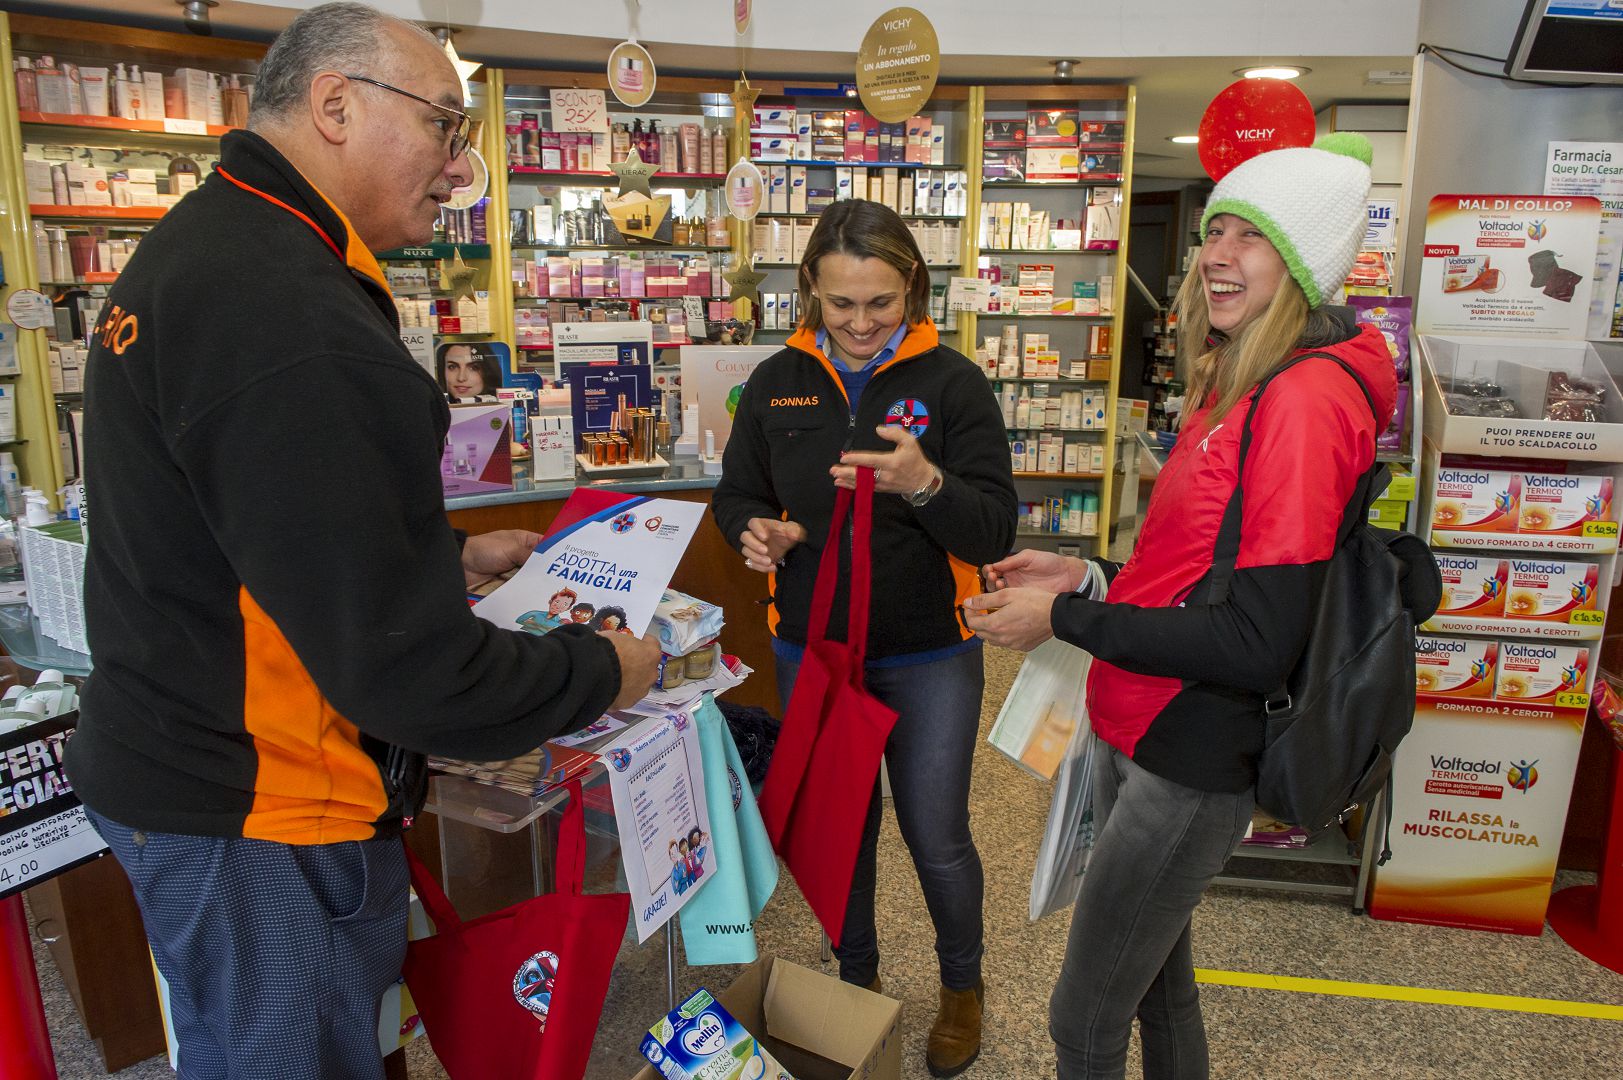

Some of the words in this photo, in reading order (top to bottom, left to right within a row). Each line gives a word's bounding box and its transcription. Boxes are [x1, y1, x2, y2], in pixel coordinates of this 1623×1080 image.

[884, 18, 912, 30] VICHY
[889, 40, 917, 57] regalo
[864, 63, 874, 71] UN
[875, 54, 931, 69] ABBONAMENTO
[555, 92, 602, 107] SCONTO
[565, 108, 596, 124] 25%
[1236, 128, 1275, 139] VICHY
[1554, 149, 1612, 162] Farmacia
[1552, 164, 1578, 175] Quey
[1581, 165, 1594, 174] Dr.
[1458, 200, 1490, 210] MAL
[1495, 200, 1510, 210] DI
[1514, 200, 1573, 212] COLLO?
[1601, 201, 1623, 209] ERVIZ
[1479, 220, 1524, 230] Voltadol
[402, 336, 424, 344] RAC
[770, 396, 819, 406] DONNAS
[1486, 428, 1512, 437] PUOI
[1515, 429, 1573, 439] PRENDERE
[1576, 432, 1595, 440] QUI
[1493, 438, 1515, 446] TUO
[1519, 439, 1597, 451] SCALDACOLLO
[1438, 471, 1489, 484] Voltadol
[1525, 475, 1579, 488] Voltadol
[1438, 482, 1473, 490] TERMICO
[1487, 539, 1530, 547] FORMATO
[1557, 542, 1594, 550] CEROTTI
[569, 546, 599, 558] progetto
[555, 552, 617, 575] ADOTTA
[619, 570, 638, 578] una
[1437, 558, 1478, 570] oltadol
[1512, 561, 1565, 574] Voltadol
[547, 563, 631, 592] FAMIGLIA
[1475, 625, 1517, 633] FORMATO
[1416, 639, 1466, 652] Voltadol
[1504, 645, 1556, 658] Voltadol
[1436, 703, 1483, 713] FORMATO
[1512, 709, 1553, 718] CEROTTI
[1431, 755, 1501, 774] Voltadol
[1432, 770, 1478, 781] TERMICO
[1447, 788, 1480, 796] medicinali
[1453, 783, 1502, 792] autoriscaldante
[1429, 809, 1503, 827] RILASSA
[1510, 820, 1519, 828] la
[1403, 823, 1539, 847] MUSCOLATURA
[643, 892, 667, 922] GRAZIE!
[691, 1023, 720, 1051] Mellin
[700, 1049, 730, 1078] Crema
[715, 1058, 735, 1077] Riso
